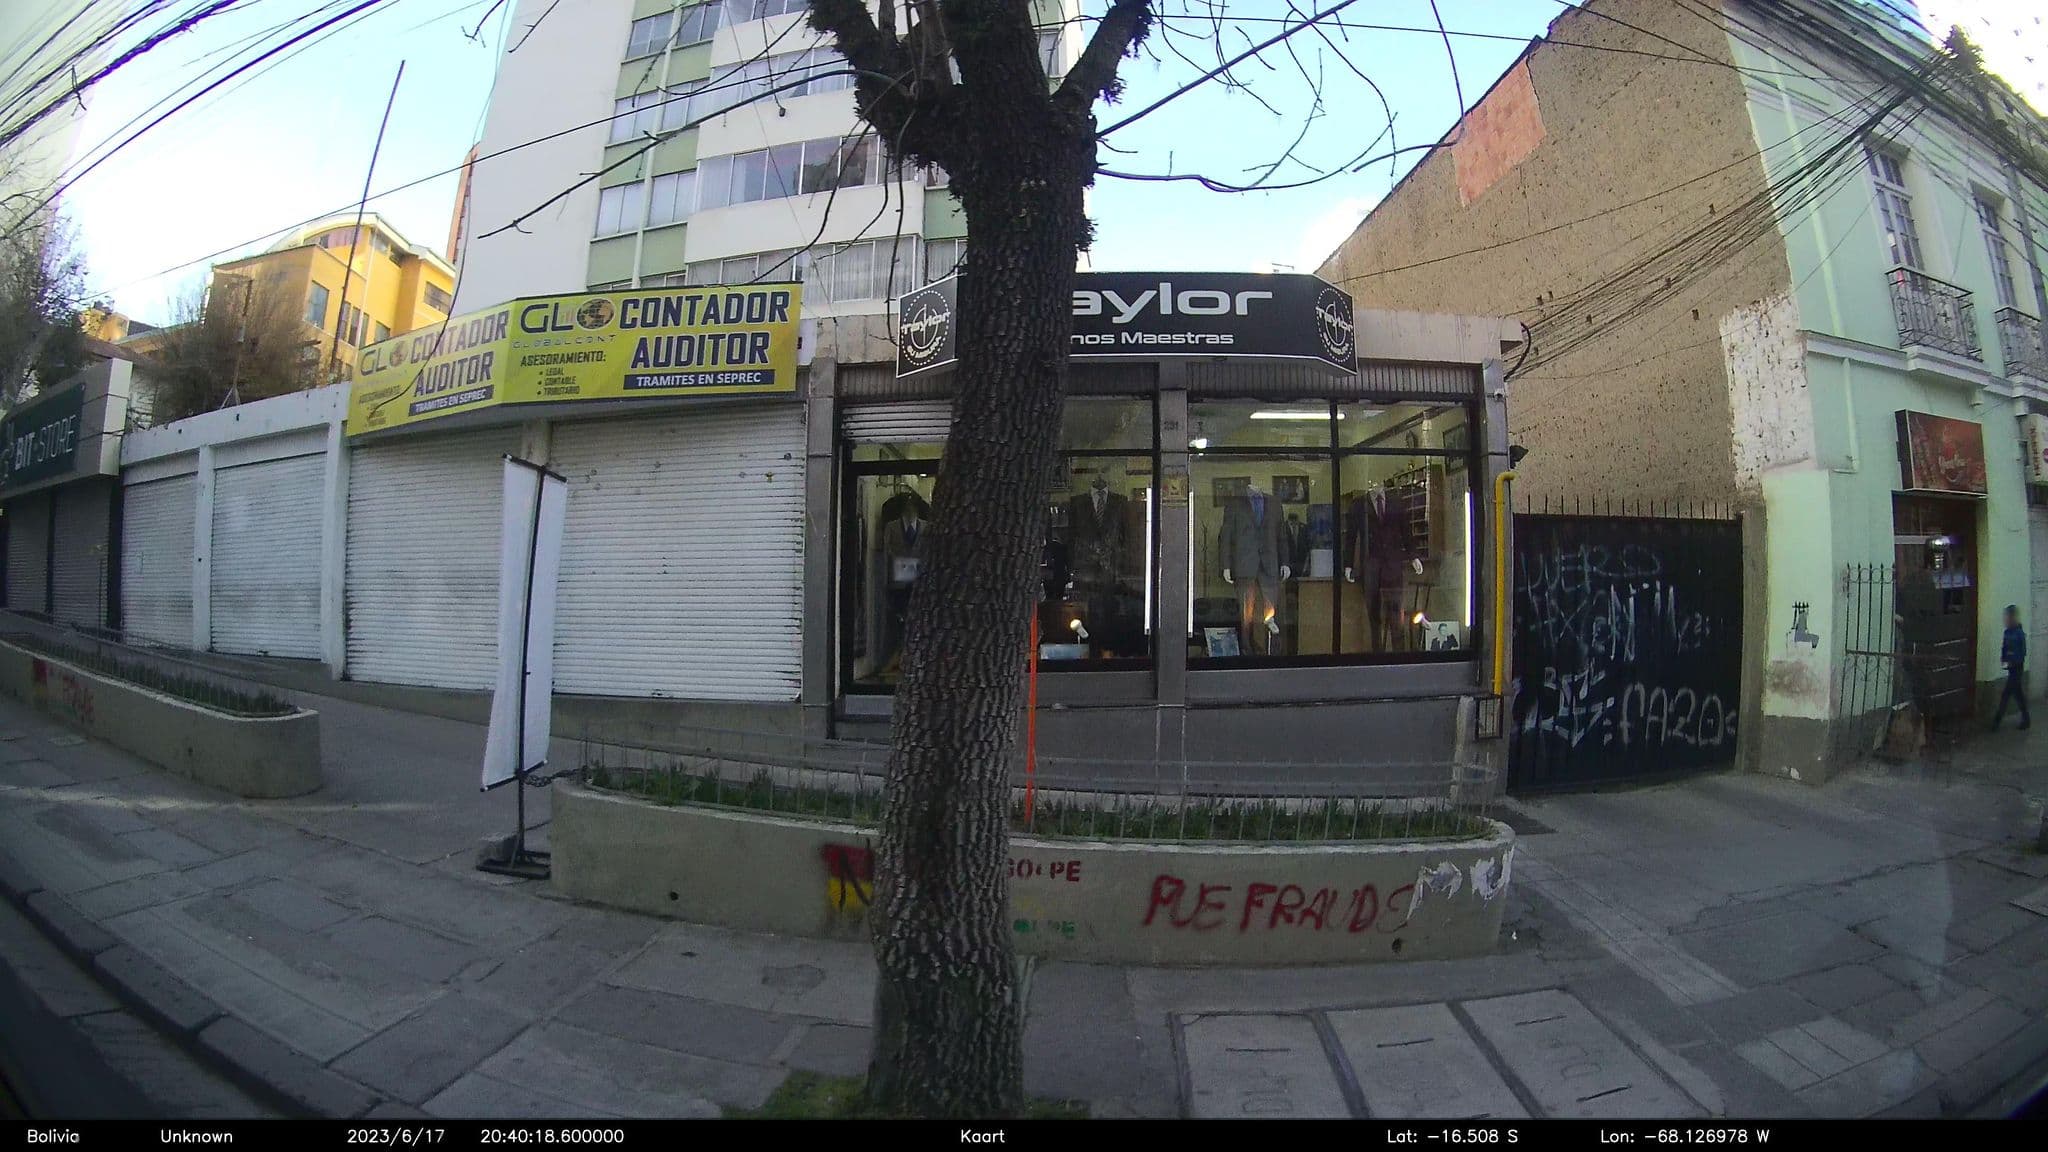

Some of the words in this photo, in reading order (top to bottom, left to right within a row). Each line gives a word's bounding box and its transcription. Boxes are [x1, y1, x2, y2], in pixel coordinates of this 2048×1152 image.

[619, 291, 790, 329] CONTADOR
[1072, 282, 1273, 324] aylor
[410, 310, 509, 364] CONTADOR
[631, 332, 770, 369] AUDITOR
[1070, 333, 1116, 345] nos
[1121, 331, 1234, 345] Maestras
[414, 351, 494, 397] AUDITOR
[636, 374, 695, 387] TRAMITES
[698, 374, 714, 385] EN
[718, 372, 762, 384] SEPREC
